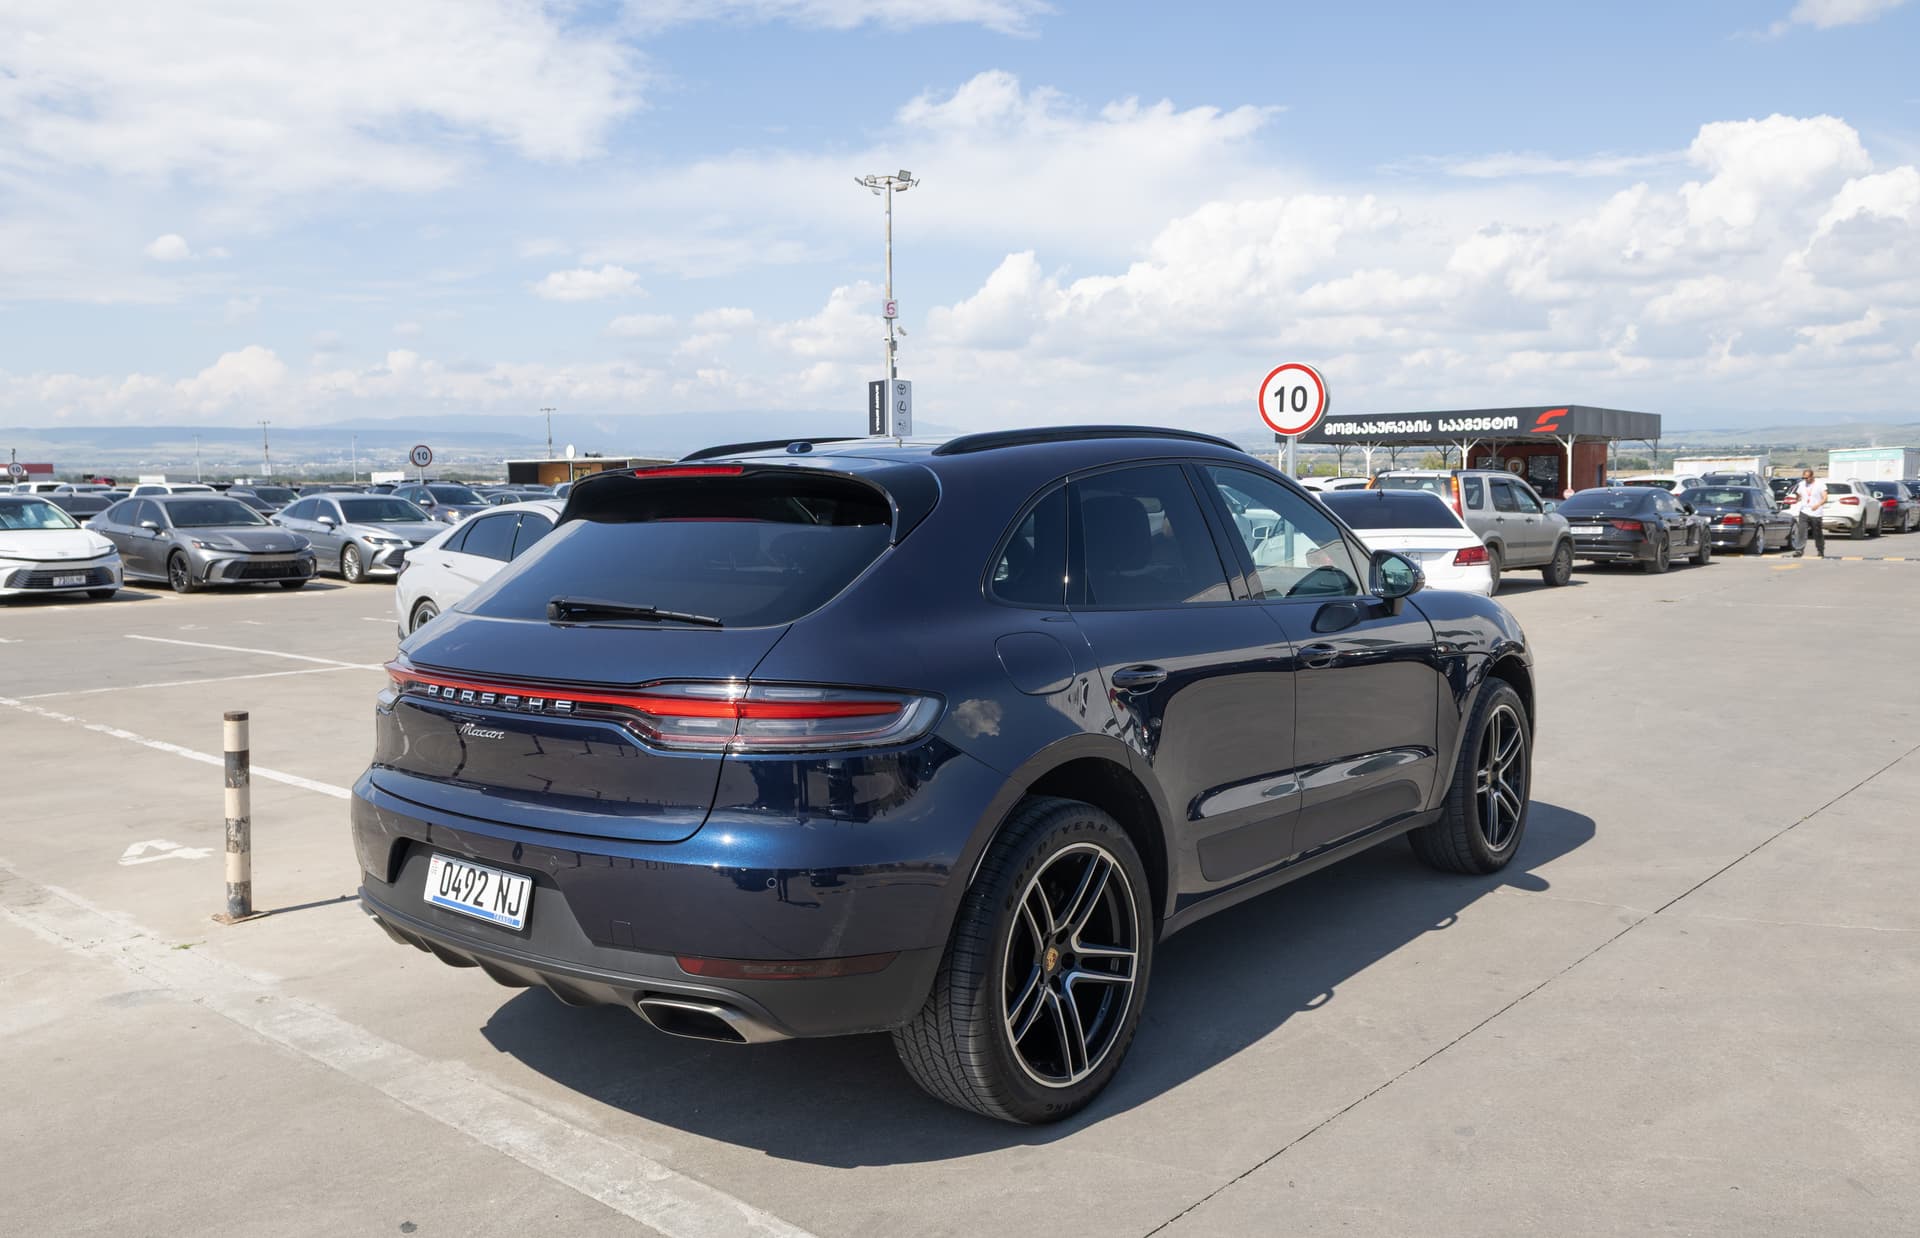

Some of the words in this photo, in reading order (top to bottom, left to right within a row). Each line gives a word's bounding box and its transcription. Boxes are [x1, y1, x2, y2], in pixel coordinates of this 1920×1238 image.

[886, 301, 896, 316] 6
[1273, 385, 1308, 413] 10
[1324, 419, 1432, 436] მომსახურების
[1438, 416, 1518, 432] სააგენტო
[416, 451, 428, 461] 10
[427, 684, 573, 713] PORSCHE
[458, 722, 505, 740] Macan
[439, 861, 489, 907] 0492
[493, 872, 525, 917] NJ
